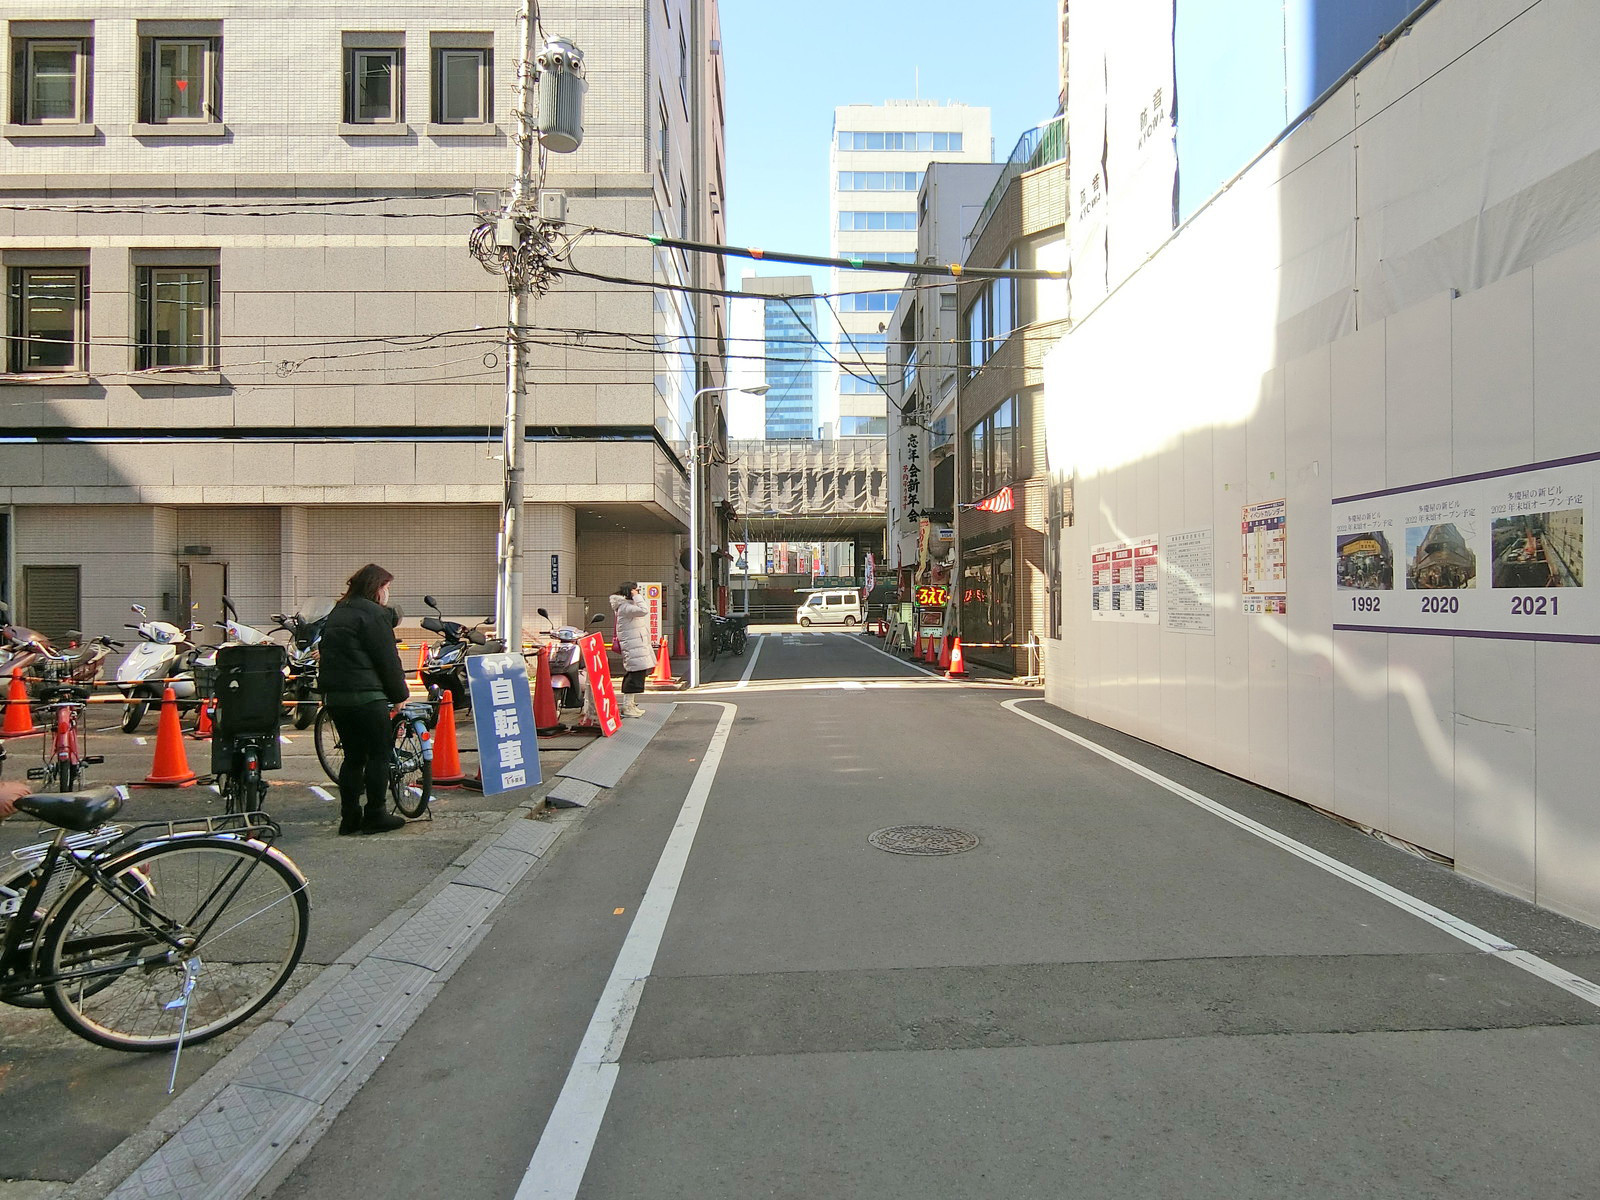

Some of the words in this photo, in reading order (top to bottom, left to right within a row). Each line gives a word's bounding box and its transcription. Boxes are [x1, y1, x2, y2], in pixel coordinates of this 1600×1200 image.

[907, 433, 921, 523] 忘年会新年会
[1508, 486, 1564, 502] 多慶屋の新ビル
[1418, 500, 1460, 513] 多慶屋の新ビル
[1351, 597, 1380, 612] 1992
[1421, 596, 1459, 614] 2020
[1511, 596, 1558, 616] 2021
[594, 650, 611, 718] バイク
[489, 677, 524, 769] 自転車
